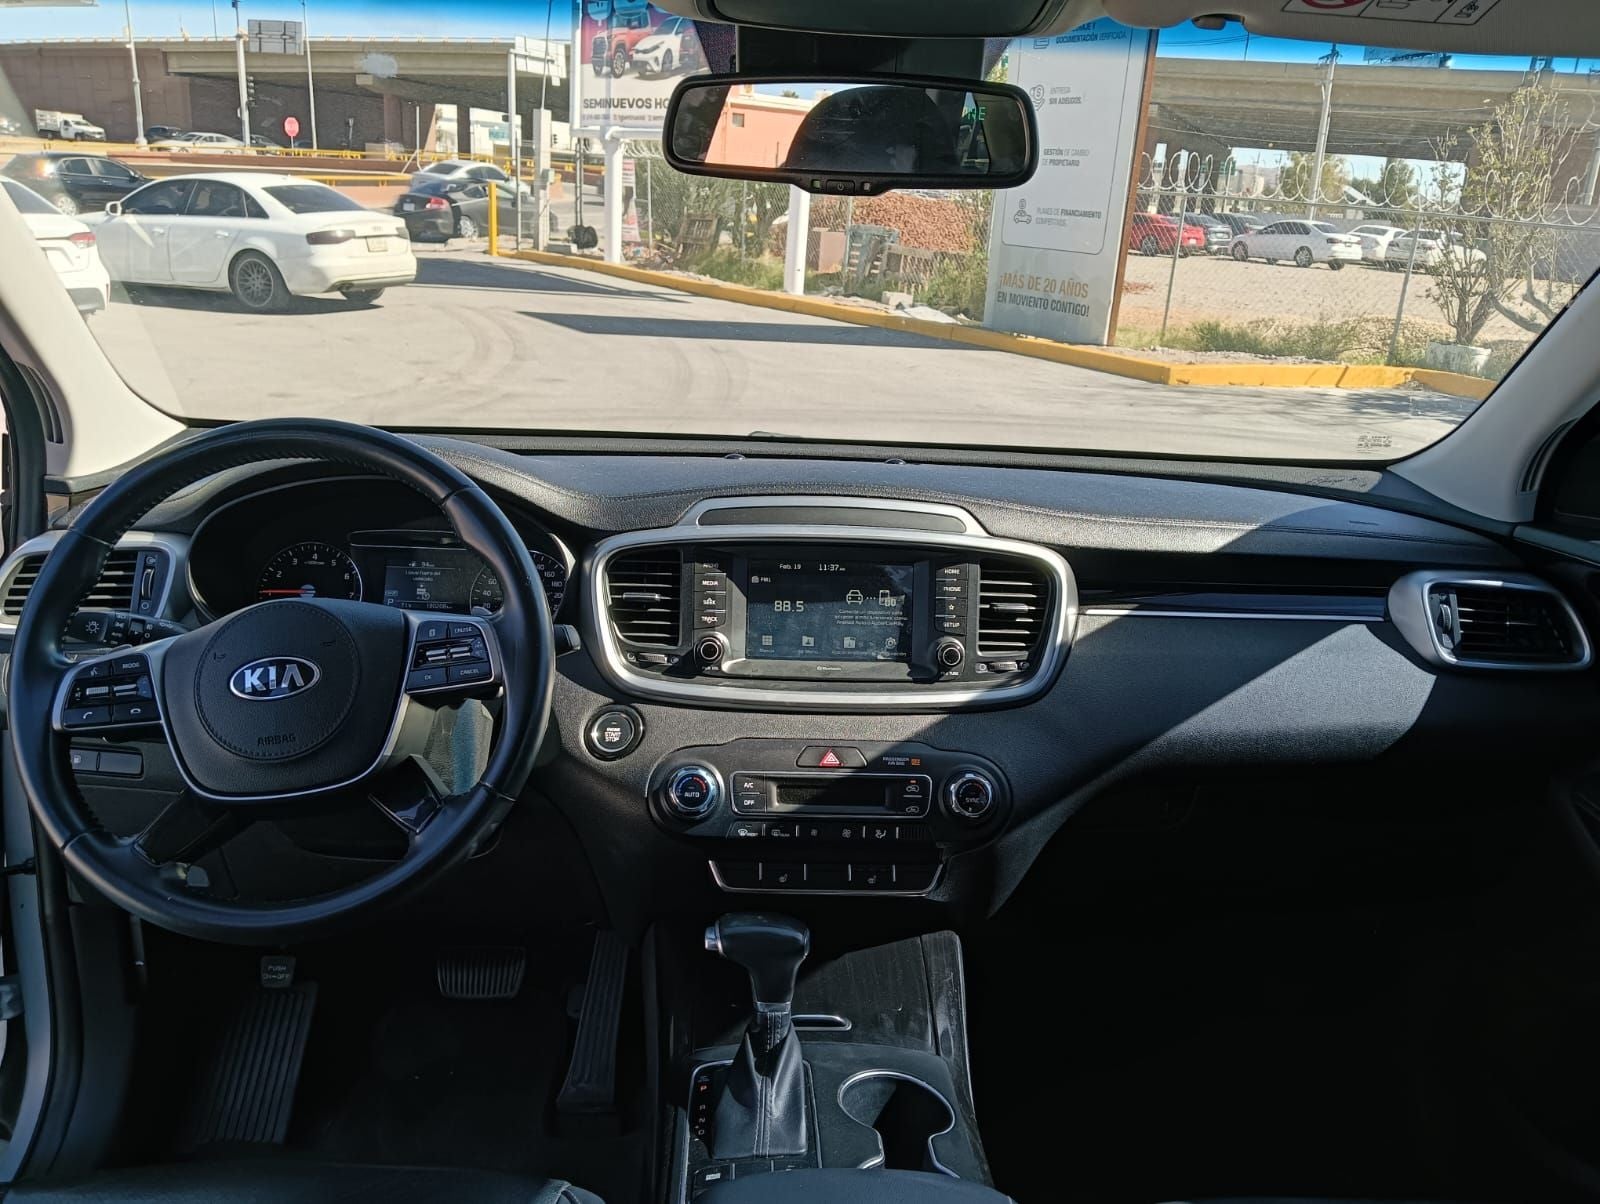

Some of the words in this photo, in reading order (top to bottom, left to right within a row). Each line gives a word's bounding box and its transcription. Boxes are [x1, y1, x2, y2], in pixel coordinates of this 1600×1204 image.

[583, 98, 652, 109] SEMINUEVOS
[1028, 276, 1041, 291] DE
[1043, 278, 1056, 293] 20
[1059, 278, 1089, 298] AÑOS
[997, 291, 1007, 303] EN
[1009, 293, 1049, 310] MOVIENTO
[1051, 299, 1090, 317] CONTIGO!
[276, 570, 282, 578] 2
[775, 601, 804, 612] 88.5
[243, 663, 305, 693] KIA
[257, 734, 296, 746] AIRBAG
